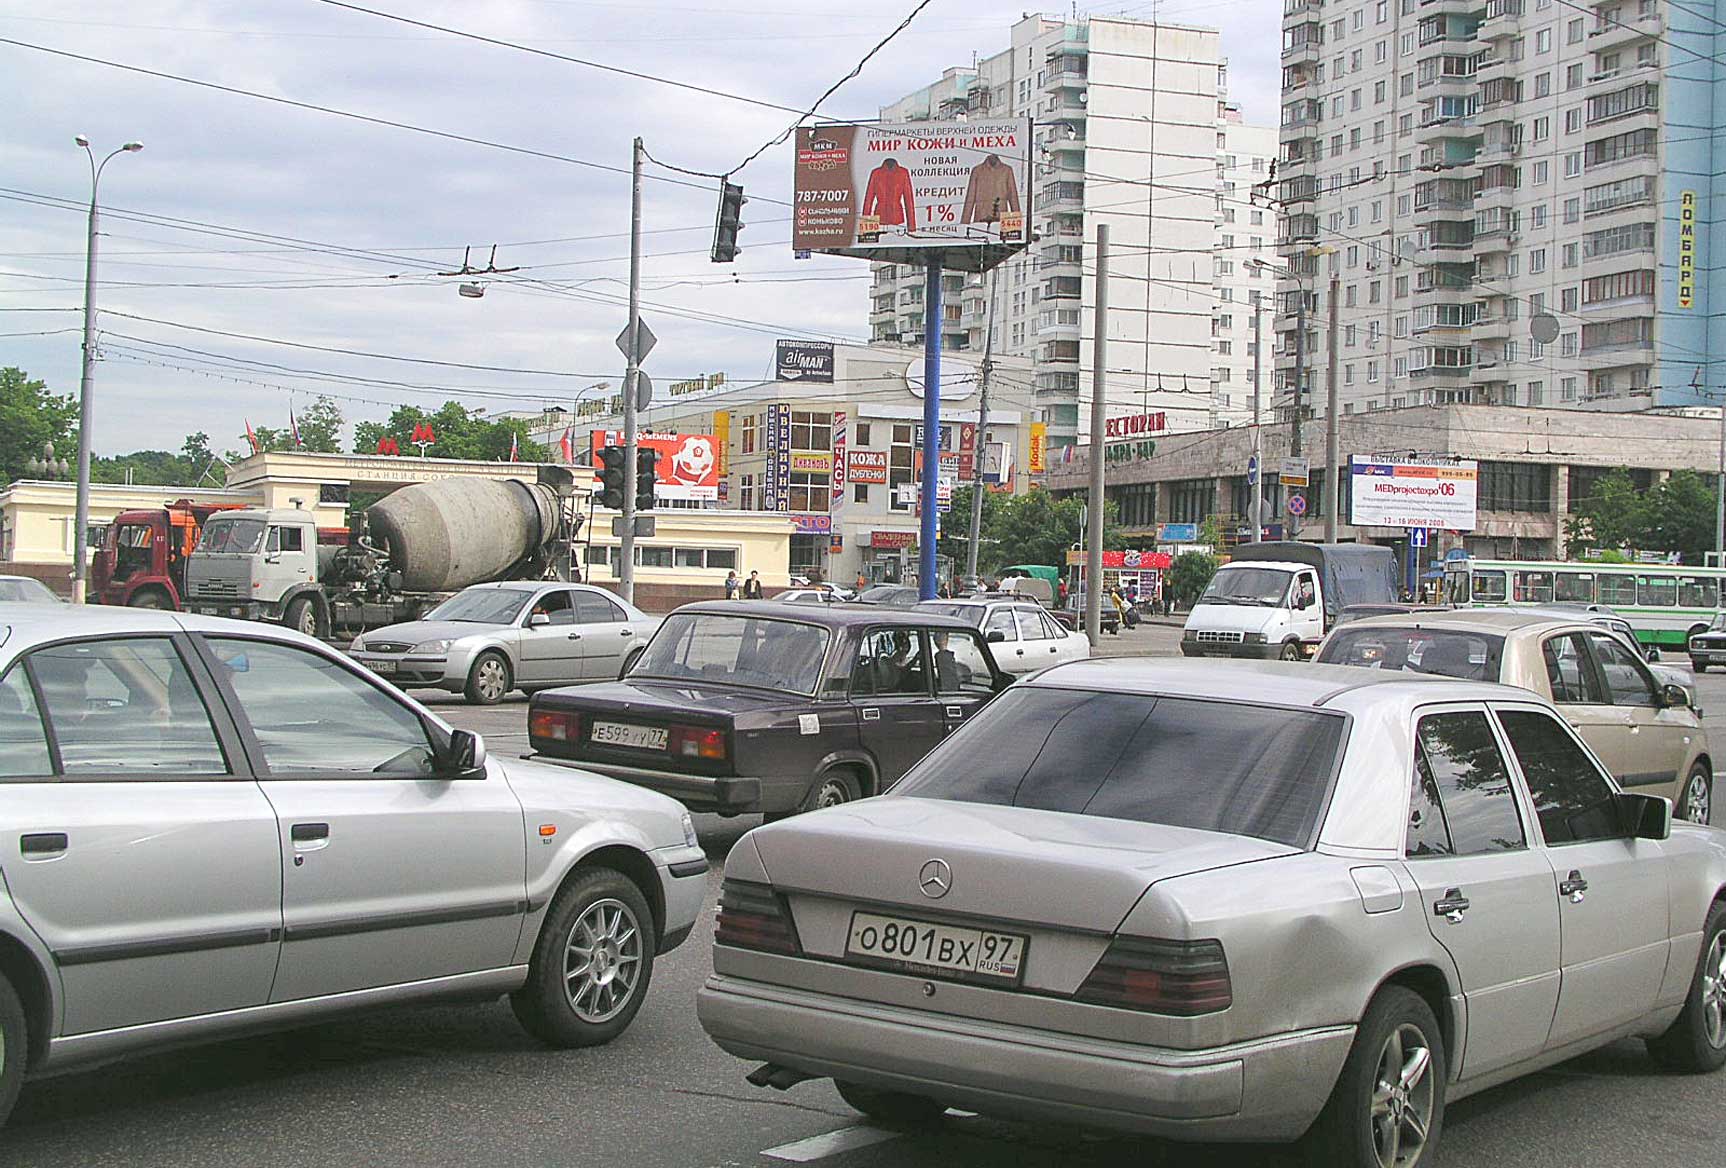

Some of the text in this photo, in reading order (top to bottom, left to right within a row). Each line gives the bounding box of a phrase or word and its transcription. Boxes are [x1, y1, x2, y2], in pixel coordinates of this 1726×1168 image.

[937, 126, 975, 135] ВЕРХНЕЙ
[978, 124, 1018, 134] ОДЕЖДЫ
[867, 140, 902, 152] МИР
[907, 137, 955, 151] КОЖИ
[971, 135, 1017, 149] МЕХА
[923, 156, 958, 166] НОВАЯ
[911, 167, 971, 178] КОЛЛЕКЦИЯ
[797, 190, 849, 202] 787-7007
[915, 187, 966, 199] КРЕДИТ
[1681, 193, 1693, 298] ЛОМБАРД
[1105, 411, 1165, 437] ЕСТОРАН
[1031, 432, 1040, 467] Kodak
[778, 404, 790, 511] ЮВЕЛИРНЫЙ
[849, 452, 886, 466] КОЖА
[833, 449, 847, 491] ЧАСЫ
[983, 935, 1013, 961] 97
[978, 960, 1000, 972] RUS
